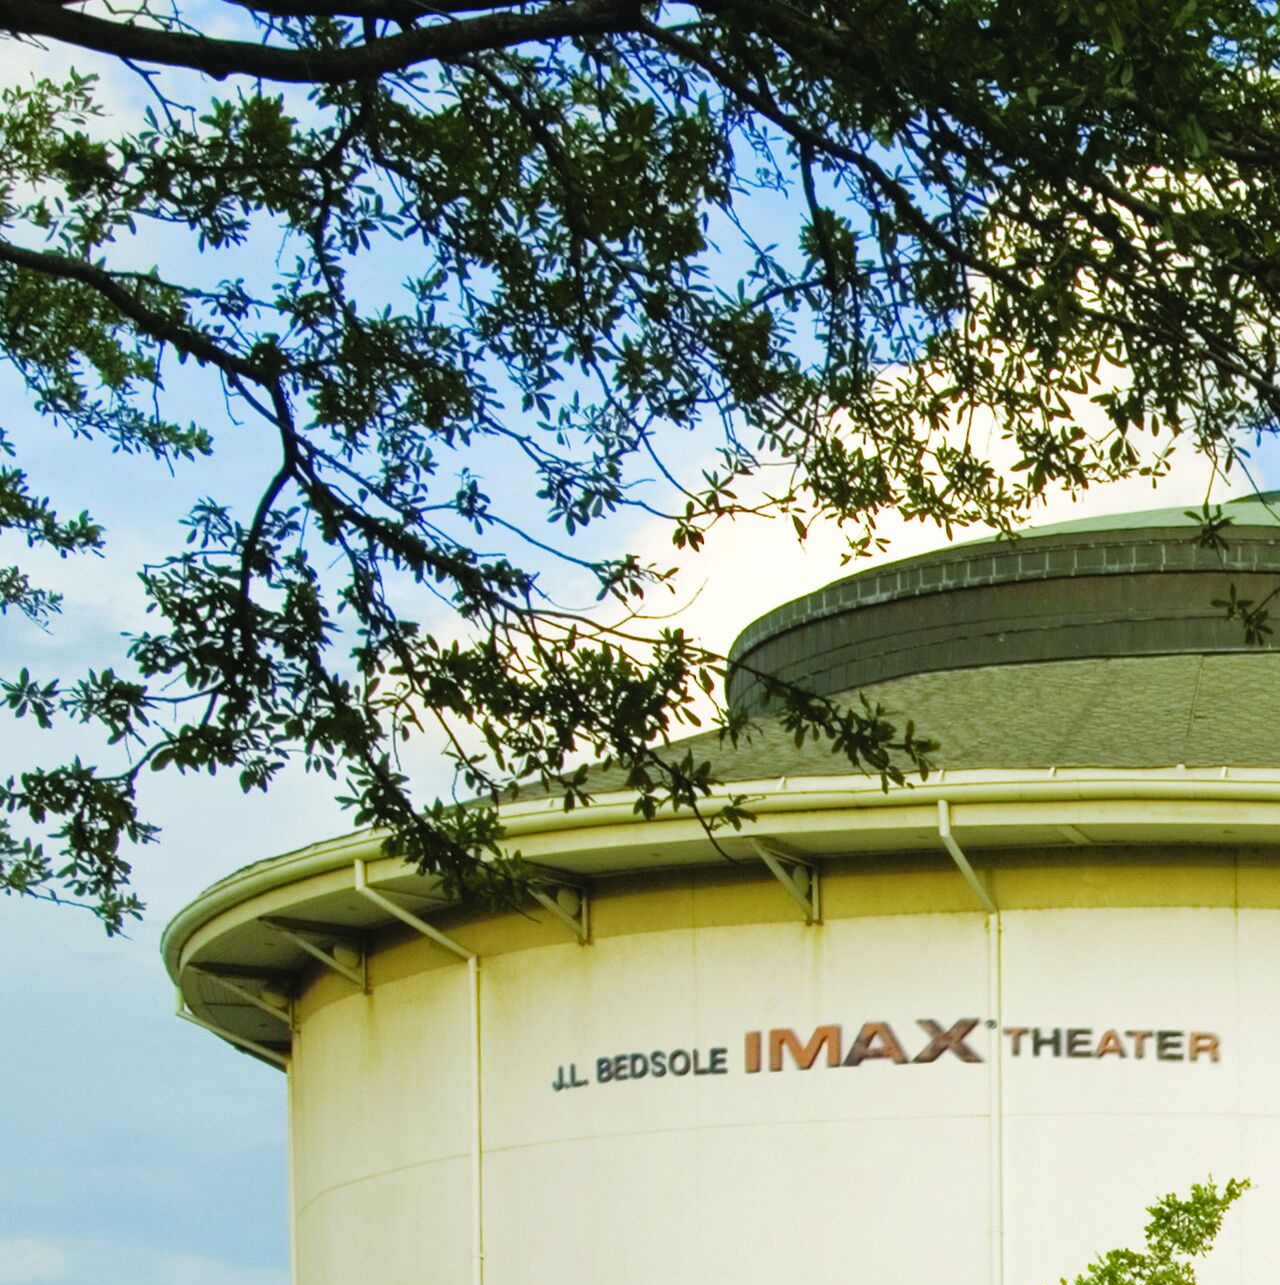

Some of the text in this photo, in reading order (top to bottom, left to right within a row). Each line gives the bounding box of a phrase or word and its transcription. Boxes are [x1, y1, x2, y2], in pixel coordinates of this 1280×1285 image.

[552, 1017, 1222, 1092] J.L. BEDSOLE IMAX THEATER
